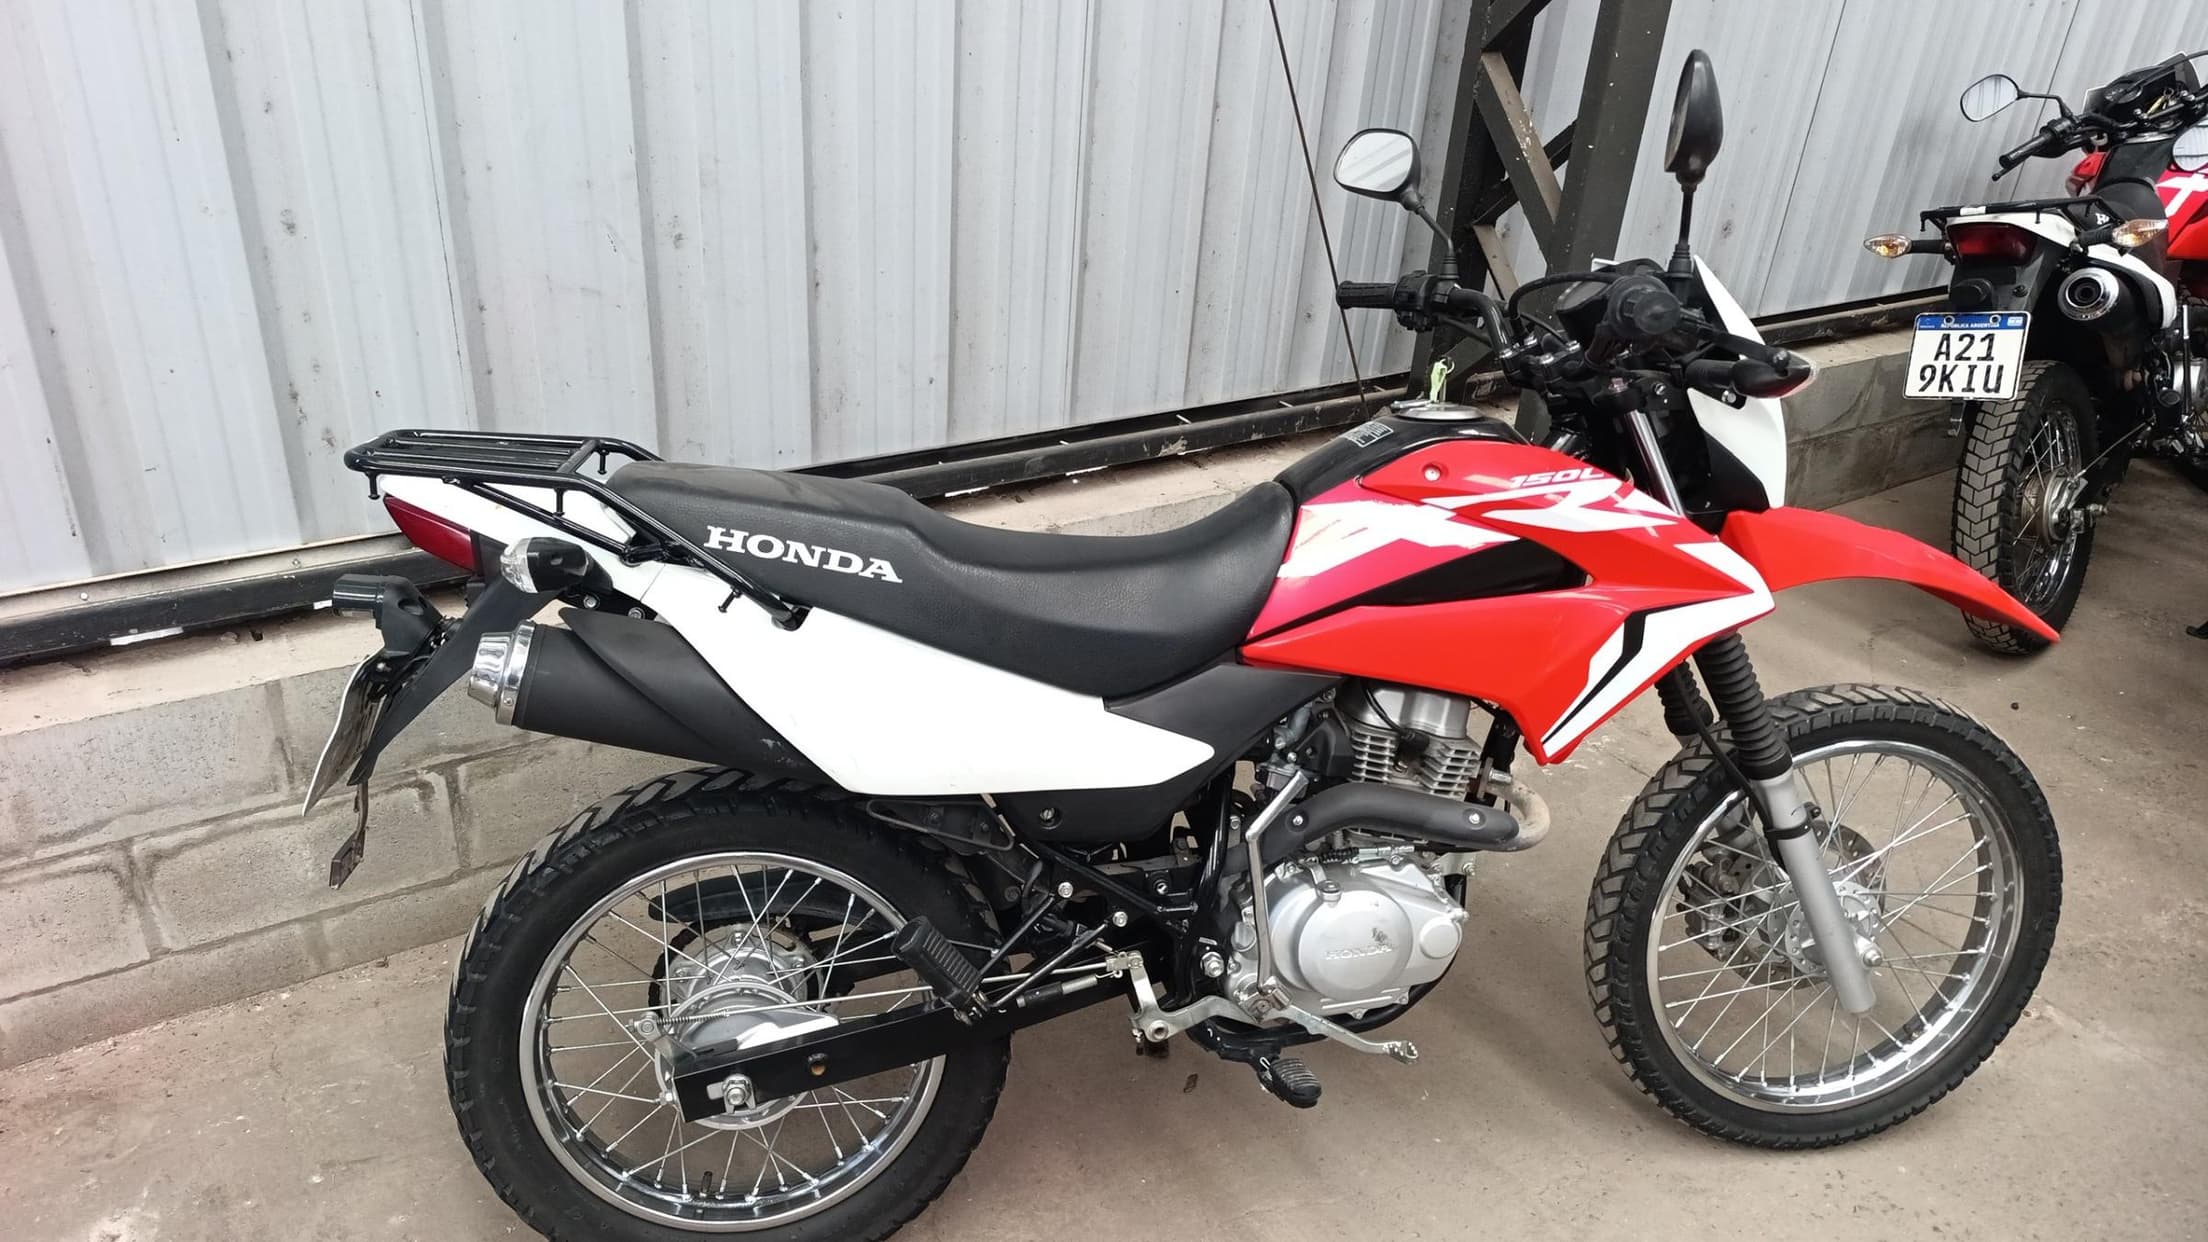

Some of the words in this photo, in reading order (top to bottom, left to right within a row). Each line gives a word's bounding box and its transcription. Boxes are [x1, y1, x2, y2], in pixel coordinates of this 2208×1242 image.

[1933, 333, 1996, 361] A21
[1918, 364, 2004, 393] 9KIU
[1509, 466, 1605, 489] 150L
[703, 525, 903, 583] HONDA
[1324, 944, 1393, 960] HONDA
